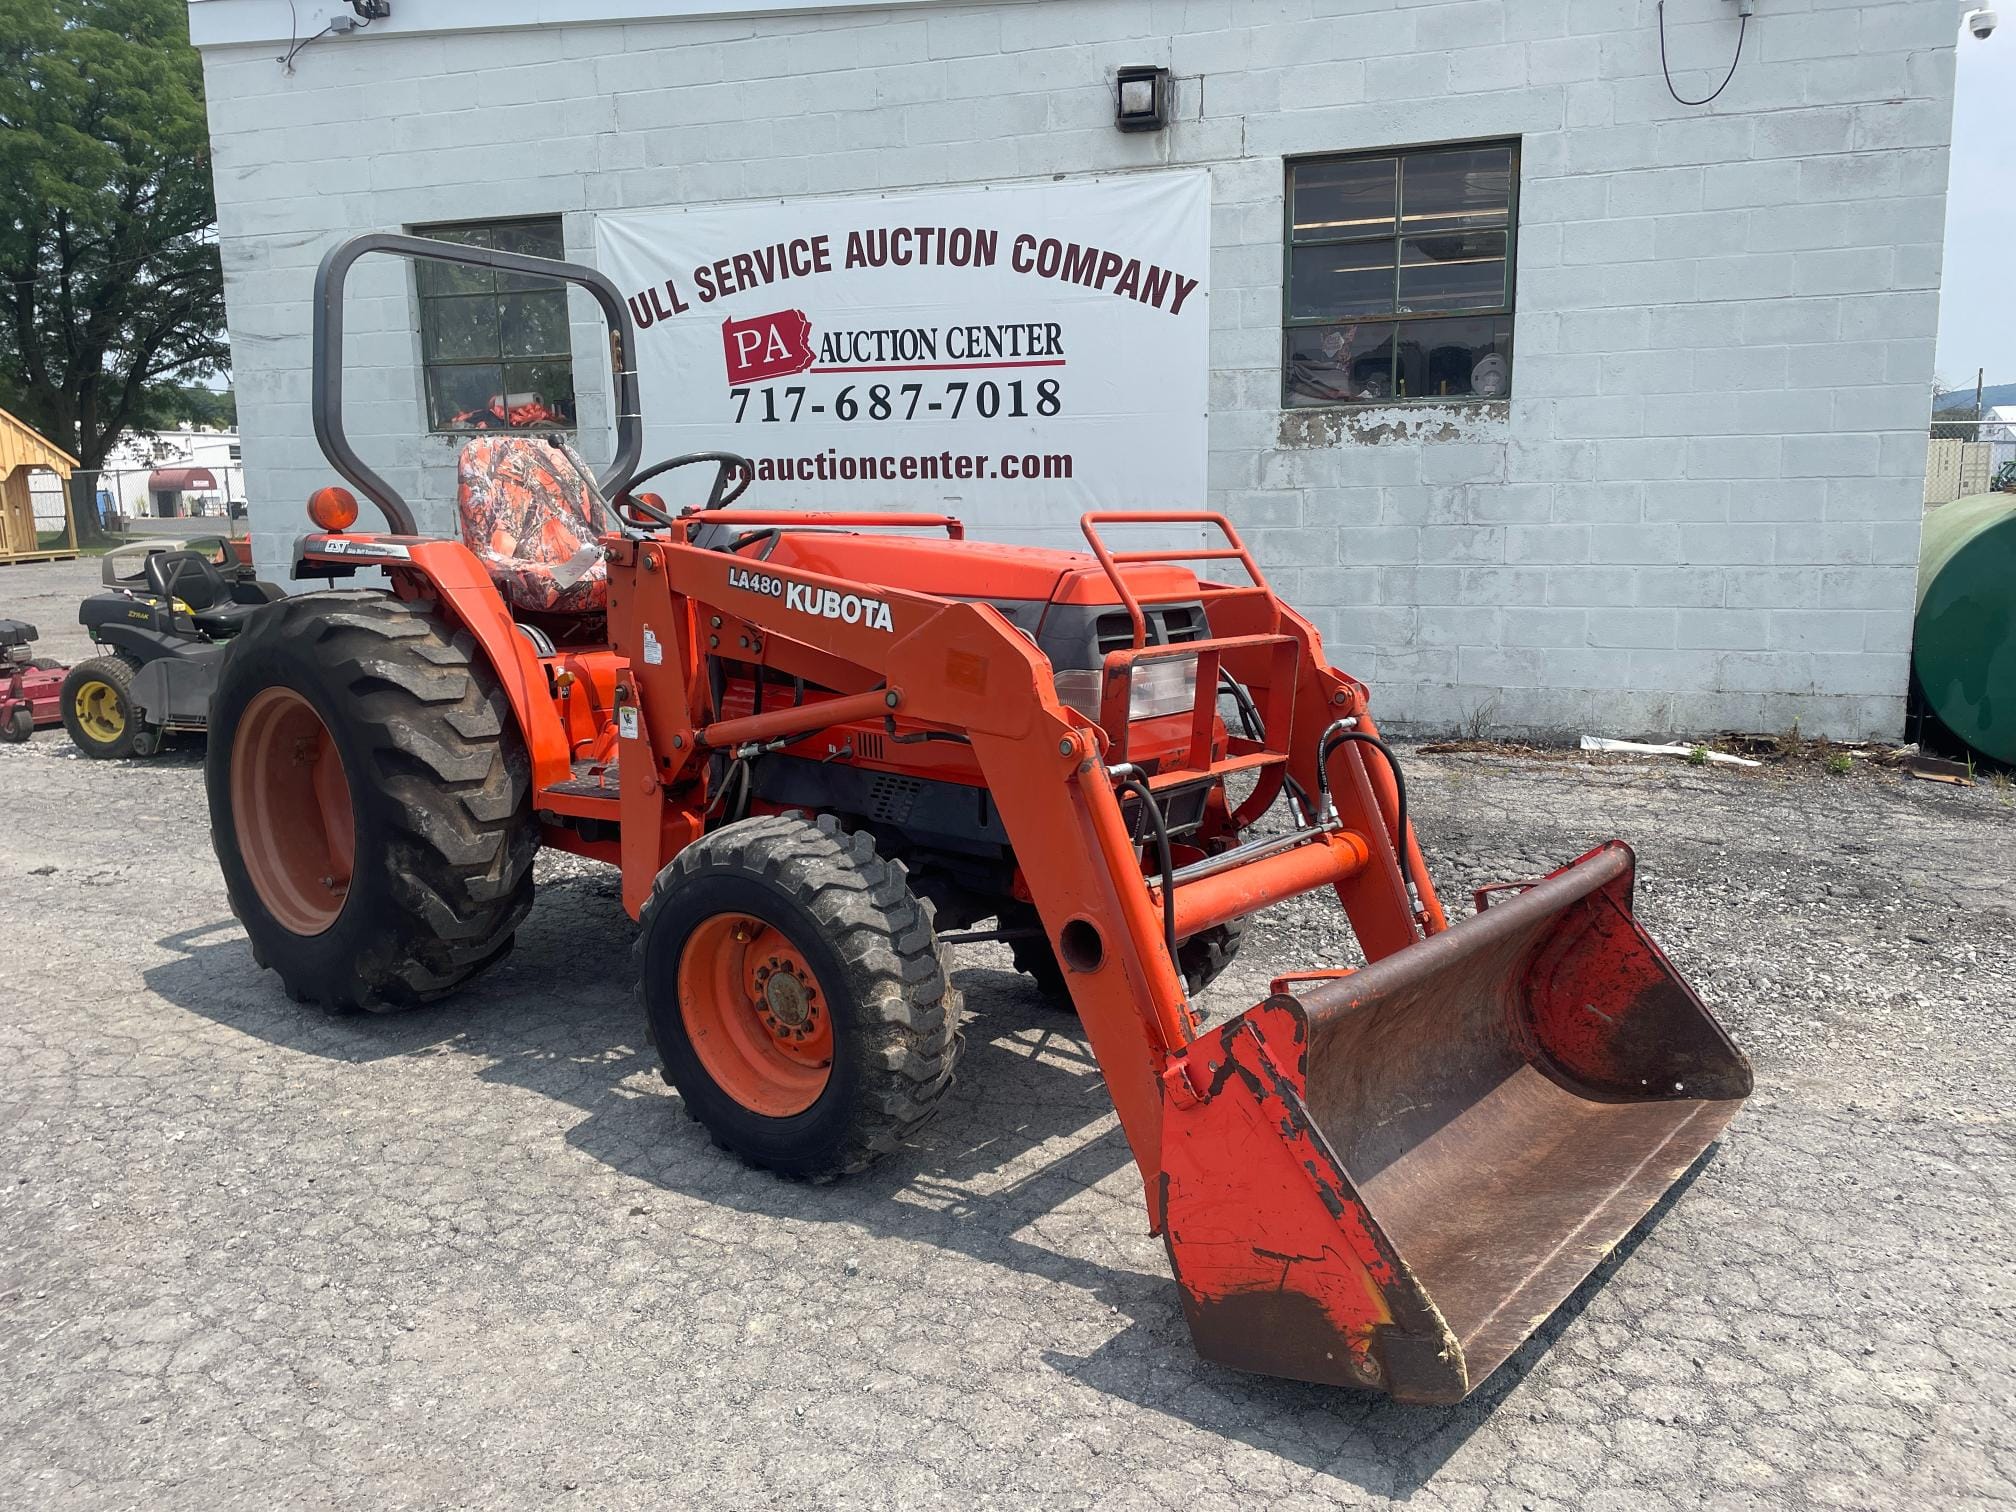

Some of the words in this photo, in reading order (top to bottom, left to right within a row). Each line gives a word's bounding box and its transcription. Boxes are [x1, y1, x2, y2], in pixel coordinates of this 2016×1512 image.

[627, 279, 689, 329] ULL
[693, 234, 832, 303] SERVICE
[845, 227, 998, 269] AUCTION
[1011, 233, 1199, 316] COMPANY
[733, 323, 792, 369] PA
[818, 327, 938, 363] AUCTION
[945, 322, 1064, 360] CENTER
[729, 378, 1061, 423] 717-687-7018
[729, 567, 782, 597] LA480
[786, 581, 894, 633] KUBOTA
